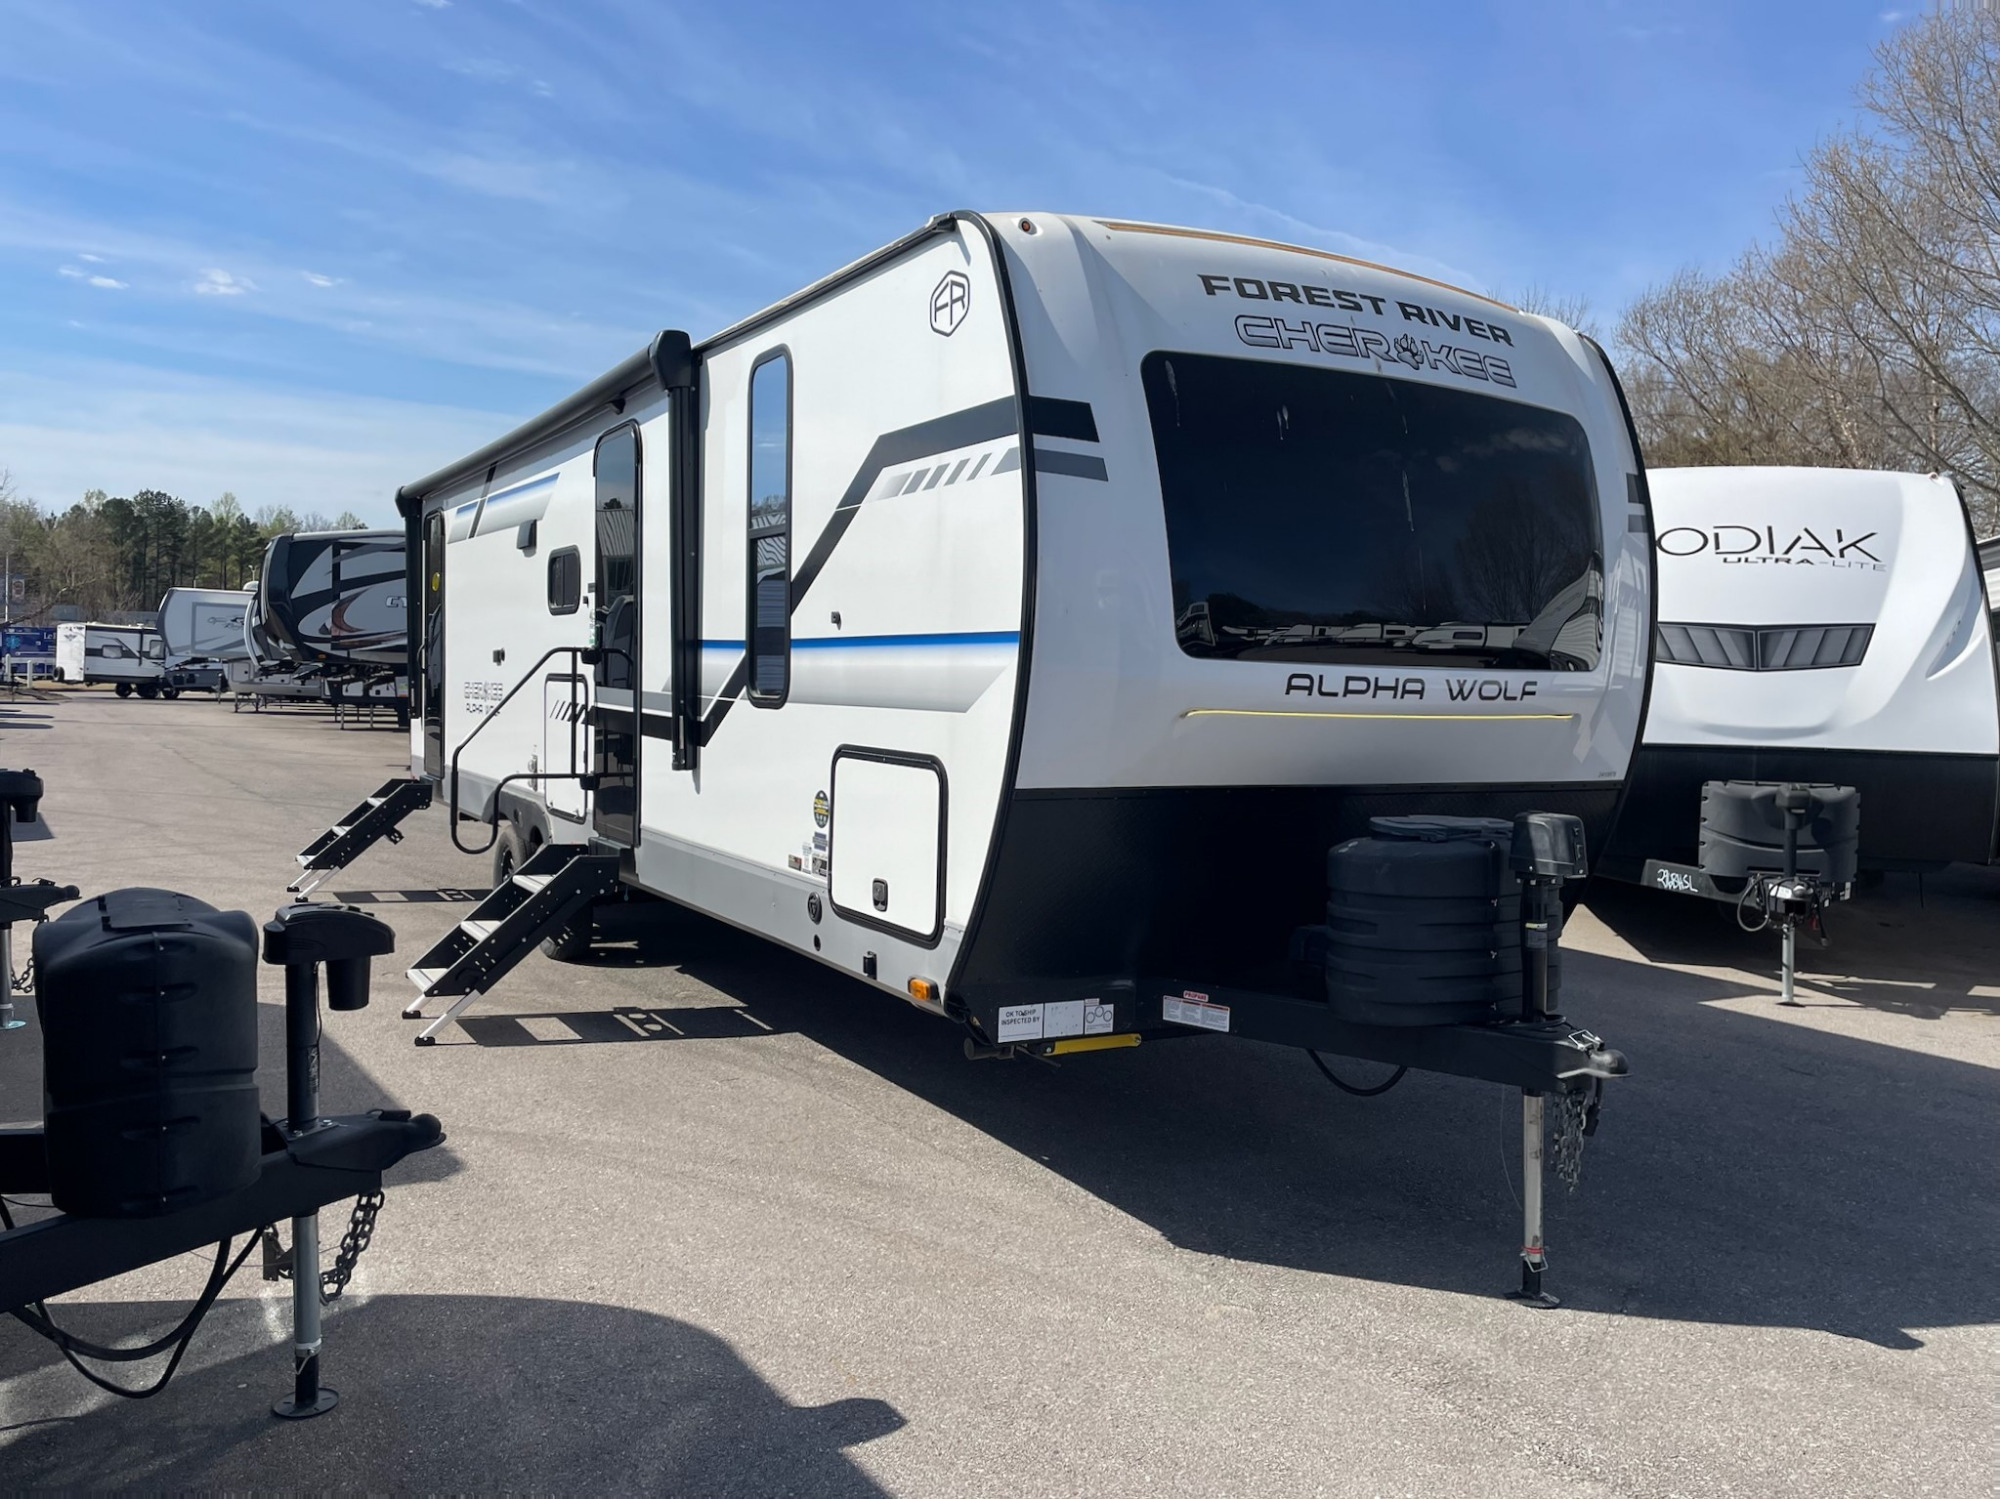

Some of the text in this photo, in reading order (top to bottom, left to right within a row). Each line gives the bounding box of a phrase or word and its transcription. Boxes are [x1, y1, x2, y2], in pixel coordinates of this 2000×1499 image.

[1197, 273, 1515, 348] FOREST RIVER
[1656, 525, 1882, 563] ODIAK
[1722, 556, 1887, 572] ULTRA-LITE
[1285, 673, 1538, 701] ALPHA WOLF
[1001, 1017, 1032, 1026] INSPECTED
